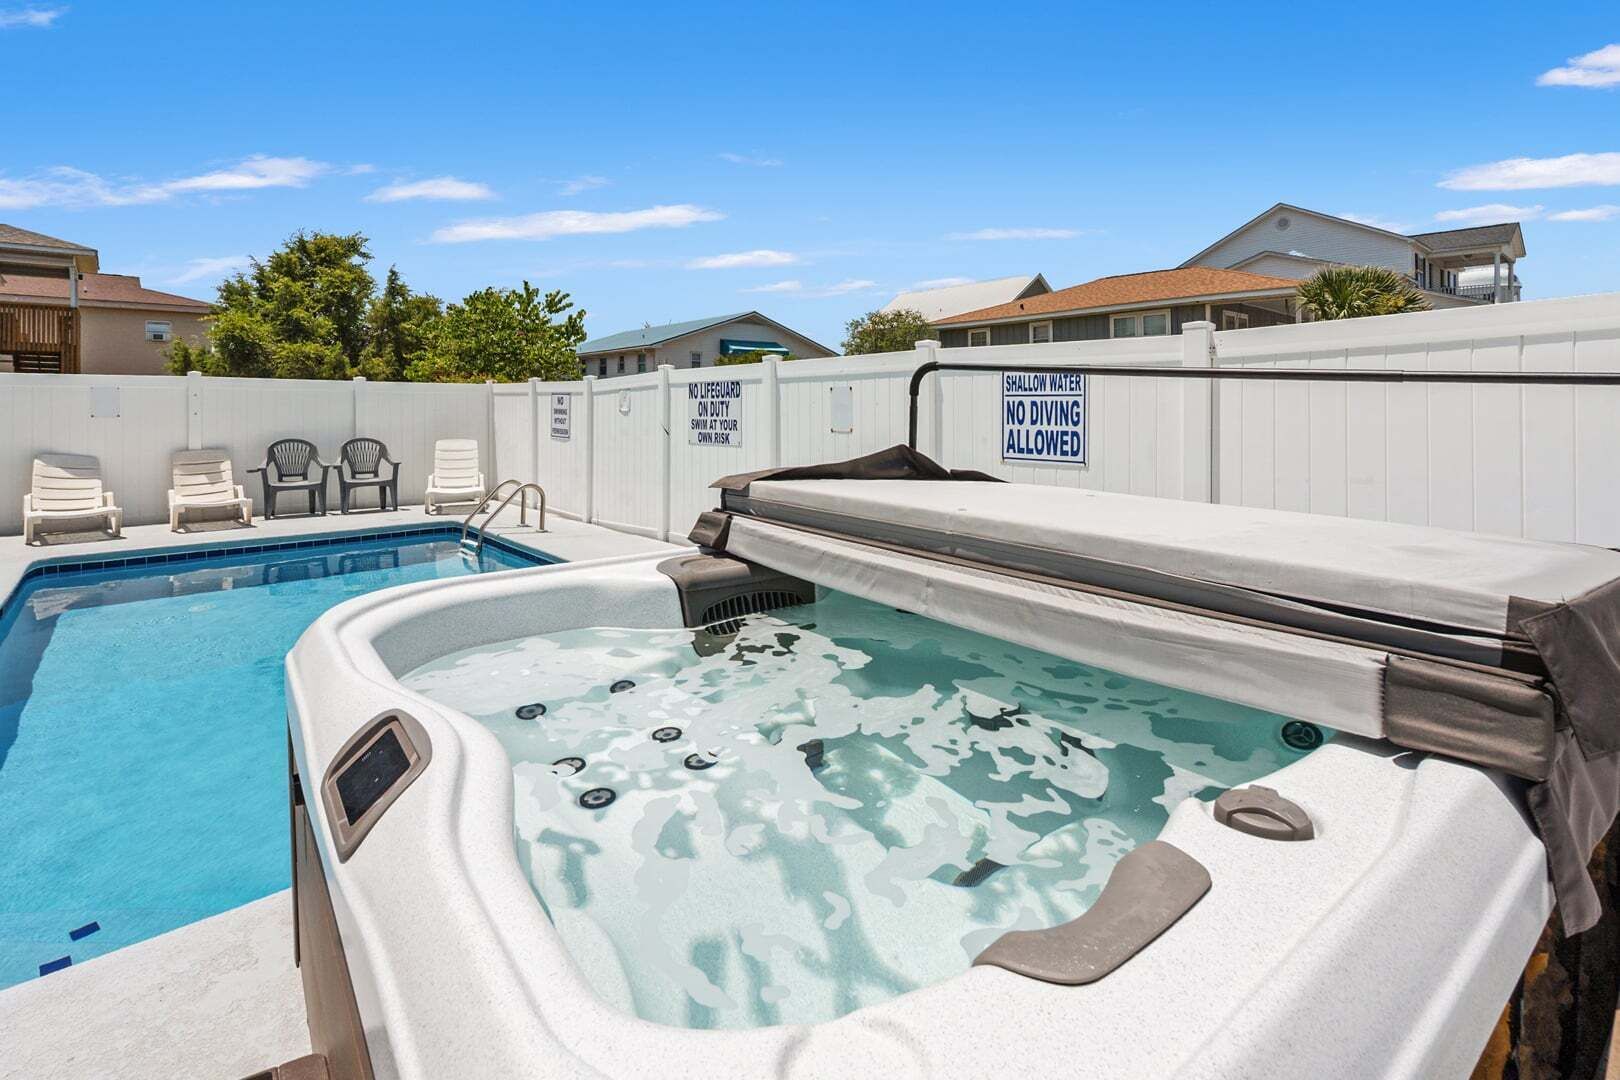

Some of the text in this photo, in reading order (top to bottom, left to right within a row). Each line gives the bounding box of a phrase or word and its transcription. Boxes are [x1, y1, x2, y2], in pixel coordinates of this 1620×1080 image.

[689, 381, 741, 399] NO LIFEGUARD
[1006, 374, 1081, 392] SHALLOW WATER
[698, 400, 730, 417] ON DUTY
[1006, 400, 1080, 427] NO DIVING
[691, 419, 738, 431] SWIM AT YOUR
[698, 431, 730, 444] OWN RISK
[1006, 429, 1081, 457] ALLOWED
